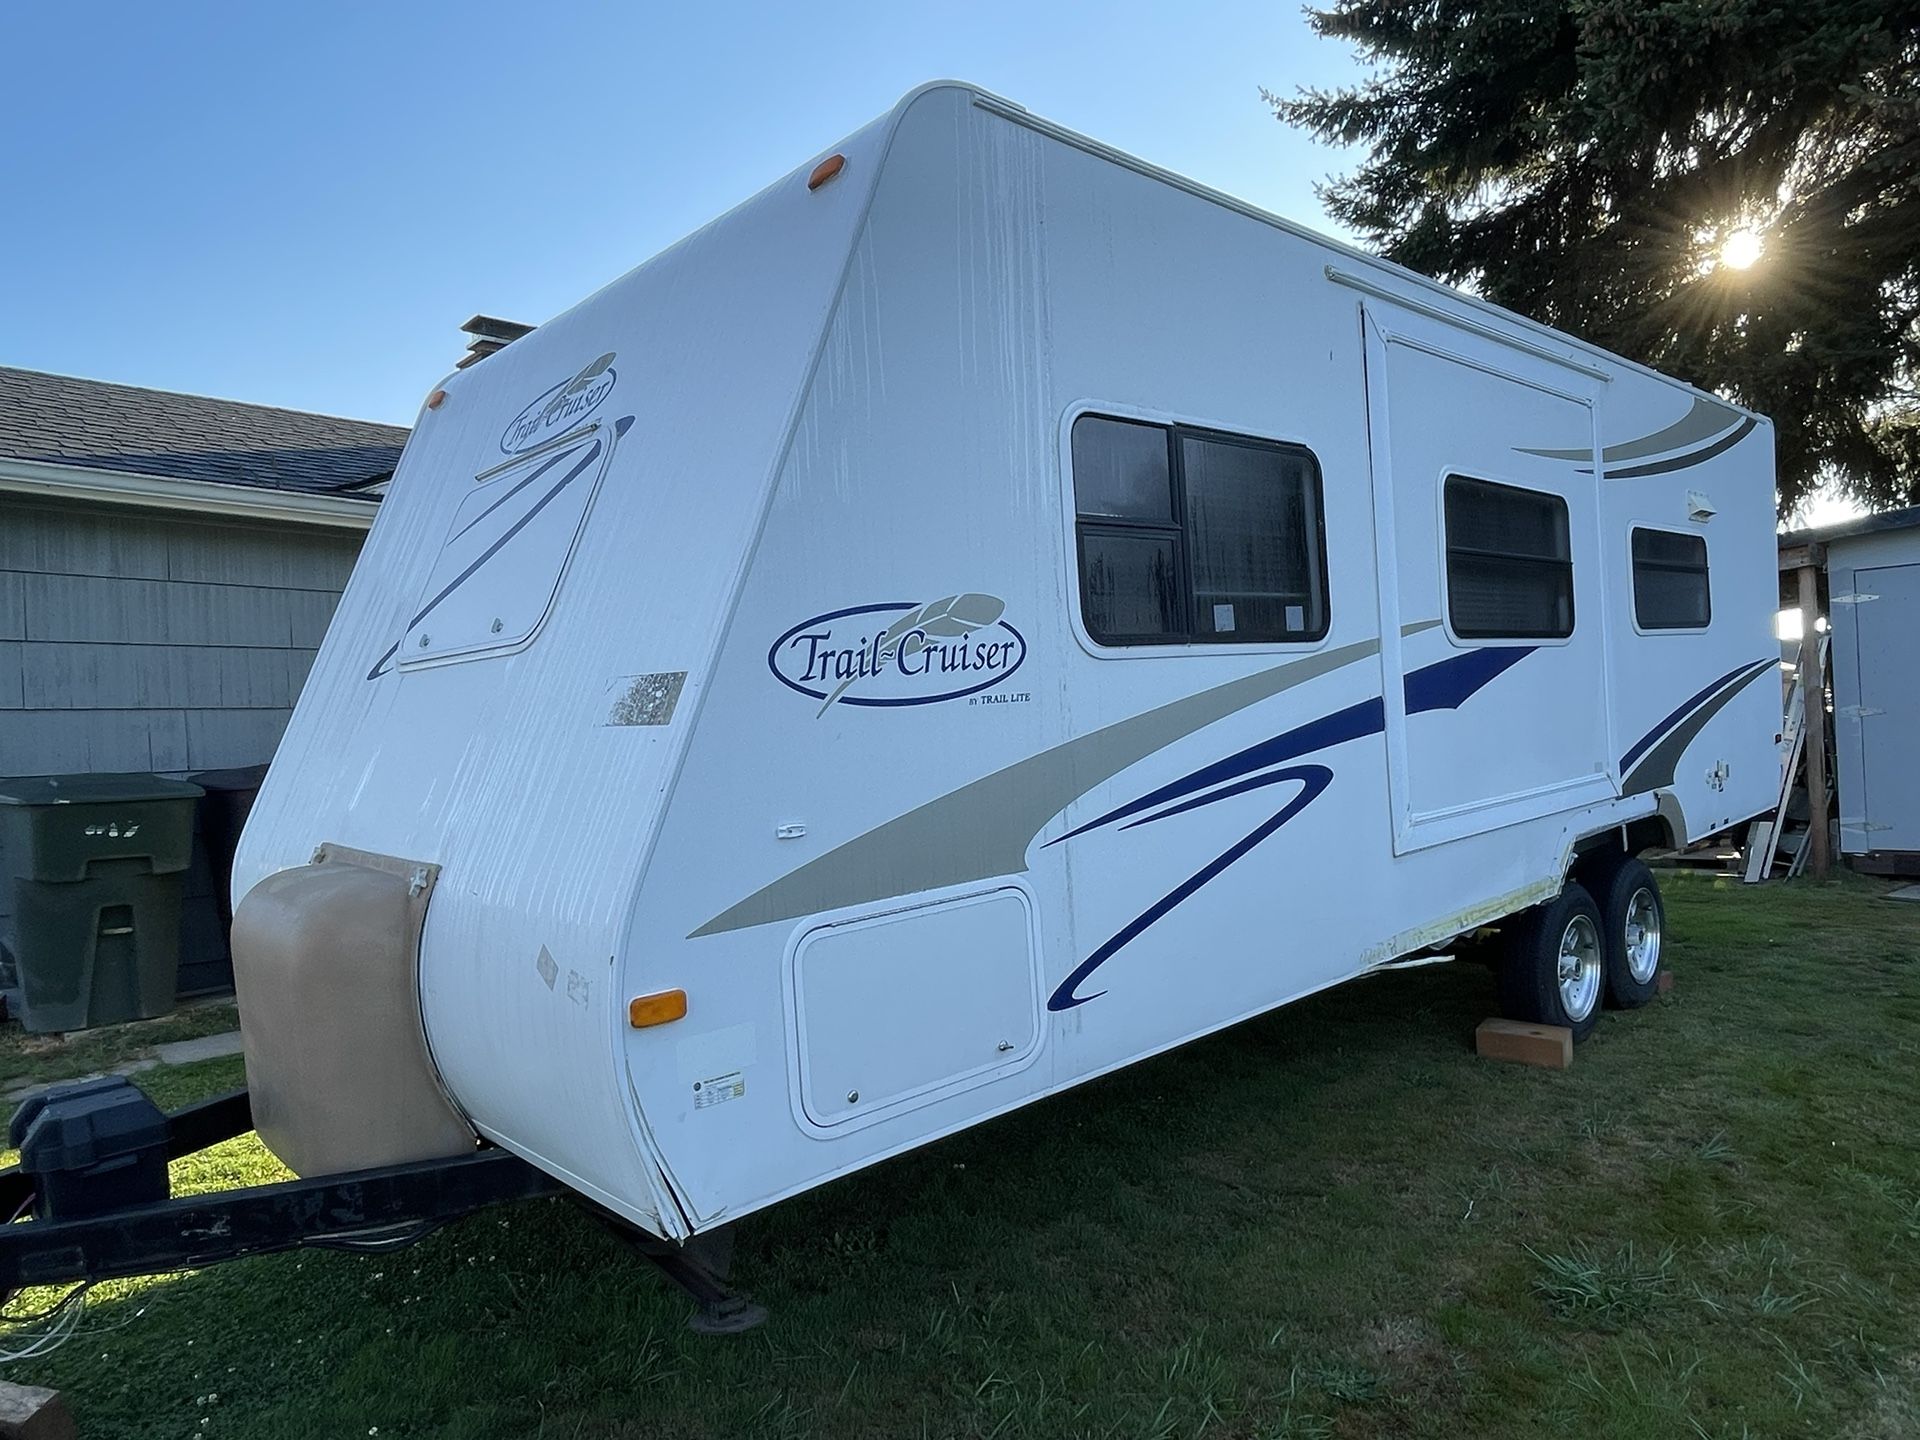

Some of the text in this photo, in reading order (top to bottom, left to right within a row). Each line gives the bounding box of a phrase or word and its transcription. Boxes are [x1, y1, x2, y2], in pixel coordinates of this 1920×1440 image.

[969, 693, 1031, 706] BY TRAIL LITE
